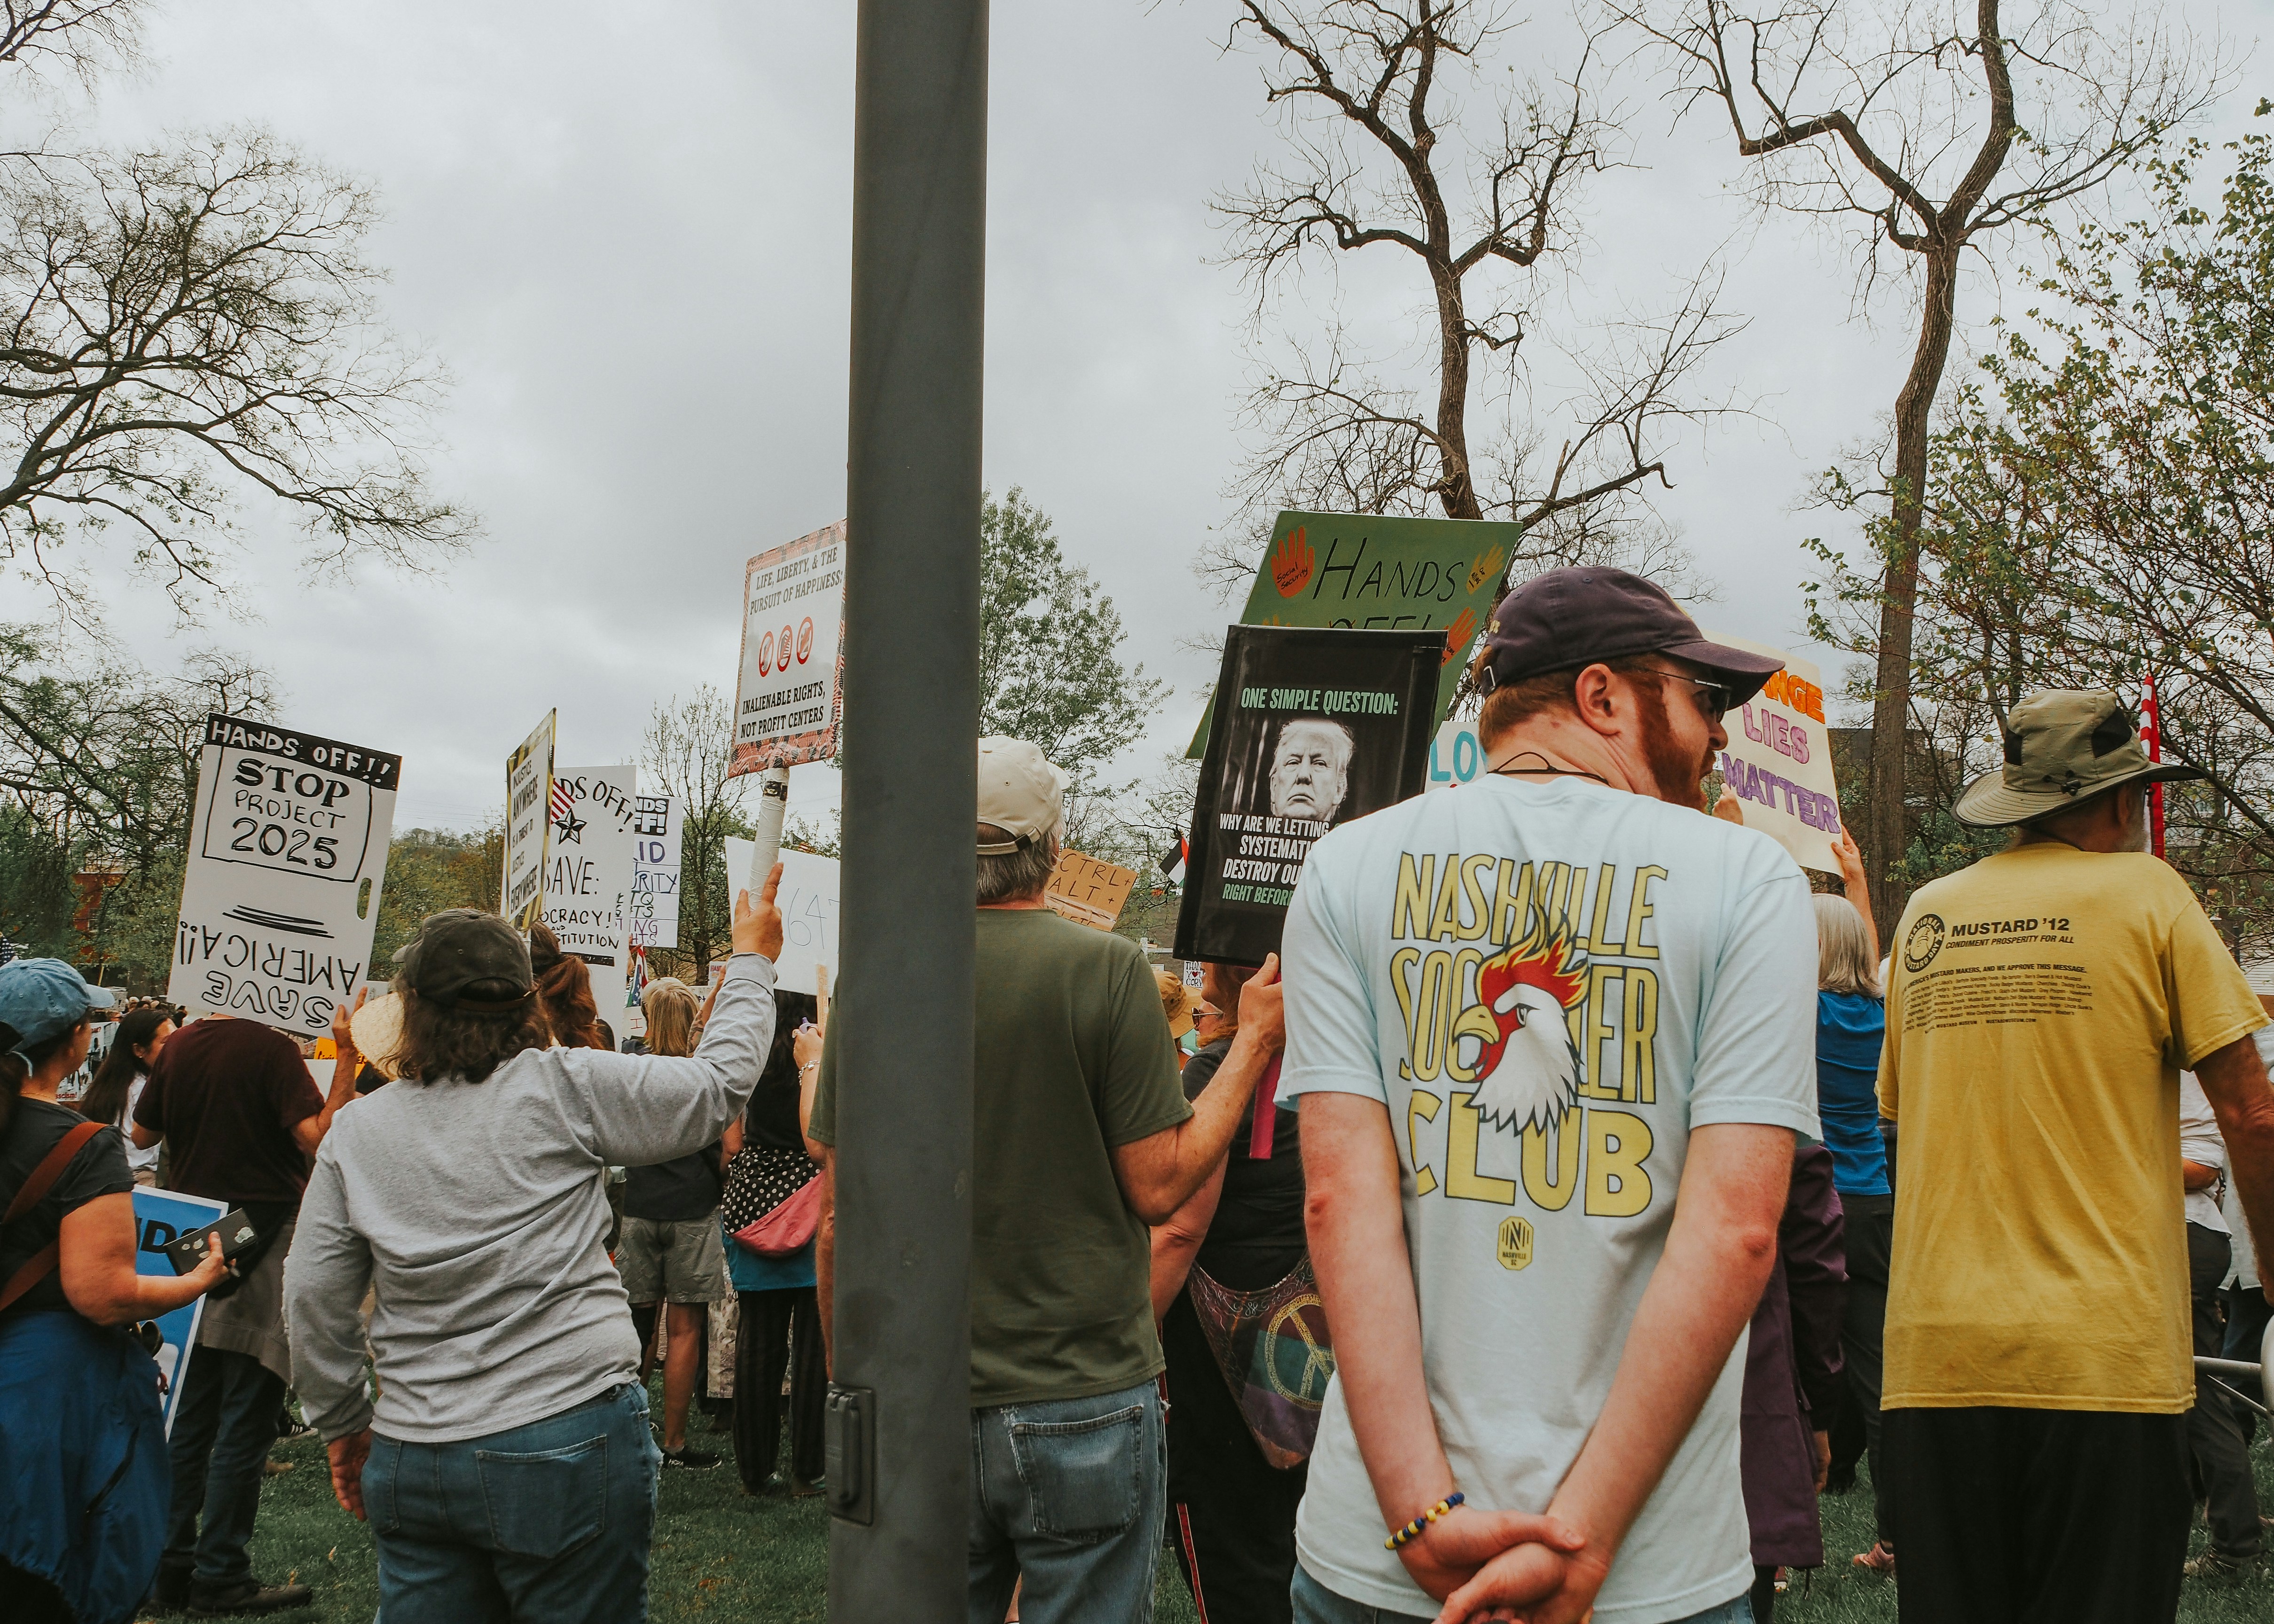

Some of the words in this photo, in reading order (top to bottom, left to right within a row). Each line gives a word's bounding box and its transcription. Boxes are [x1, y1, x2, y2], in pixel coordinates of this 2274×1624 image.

[756, 571, 775, 591] LIFE,
[776, 558, 809, 583] LIBERTY,
[812, 555, 818, 570] &
[821, 547, 838, 567] THE
[1277, 562, 1298, 583] Social
[1281, 567, 1308, 589] Security
[1313, 537, 1464, 602] HANDS
[750, 591, 781, 616] PURSUIT
[784, 587, 793, 602] OF
[795, 570, 843, 599] HAPPINESS:
[742, 688, 792, 715] INALIENABLE
[793, 680, 825, 700] RIGHTS,
[1241, 687, 1267, 708] ONE
[1269, 688, 1320, 710] SIMPLE
[1323, 690, 1398, 715] QUESTION:
[1762, 670, 1825, 724] NGE
[741, 721, 756, 739] NOT
[758, 714, 786, 736] PROFIT
[789, 706, 823, 728] CENTERS
[1742, 703, 1809, 764] LIES
[212, 721, 299, 756] HANDS
[313, 746, 392, 783] OFF!!
[1430, 731, 1487, 782] LO
[233, 758, 350, 807] STOP
[1722, 752, 1841, 834] MATTER
[236, 789, 345, 829] PROJECT
[593, 781, 633, 833] OFF!
[1220, 813, 1242, 830] WHY
[1243, 815, 1263, 832] ARE
[1266, 817, 1282, 834] WE
[1284, 819, 1329, 837] LETTING
[231, 817, 338, 869] 2025
[634, 841, 666, 863] ID
[1239, 835, 1315, 860] SYSTEMATI
[1223, 859, 1281, 882] DESTROY
[1222, 883, 1254, 902] RIGHT
[1392, 851, 1668, 960] NASHVILLE
[1909, 917, 1940, 940] NATIONAL
[1945, 939, 1990, 949] CONDIMENT
[1991, 935, 2039, 945] PROSPERITY
[1951, 919, 2038, 938] MUSTARD
[1928, 943, 1939, 958] DAY
[202, 970, 334, 1028] SAVE
[1389, 947, 1659, 1105] SOCER
[1409, 1088, 1654, 1218] CLUB
